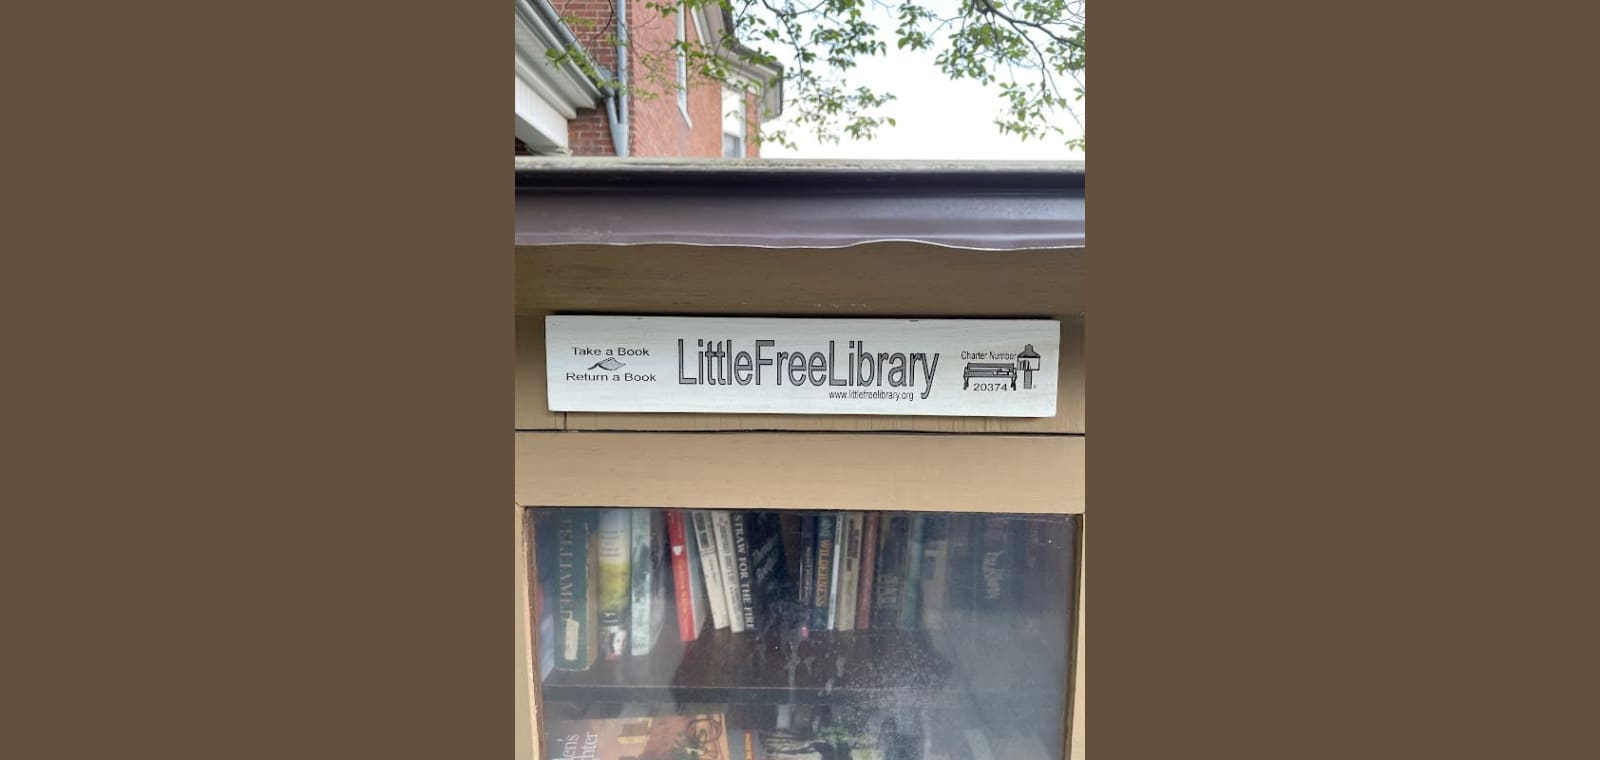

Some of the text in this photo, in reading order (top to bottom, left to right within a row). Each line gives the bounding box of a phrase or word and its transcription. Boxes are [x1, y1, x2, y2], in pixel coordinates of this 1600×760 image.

[572, 346, 650, 356] Take a Book
[960, 350, 1017, 360] Charter Number
[677, 338, 940, 400] LittleFreeLibrary
[566, 372, 656, 382] Return a Book
[973, 382, 1008, 392] 20374
[829, 390, 914, 401] www.littlefreelibrary.org
[733, 514, 755, 630] STRAW FOR THE FIRE
[815, 539, 833, 608] WILDERNESS
